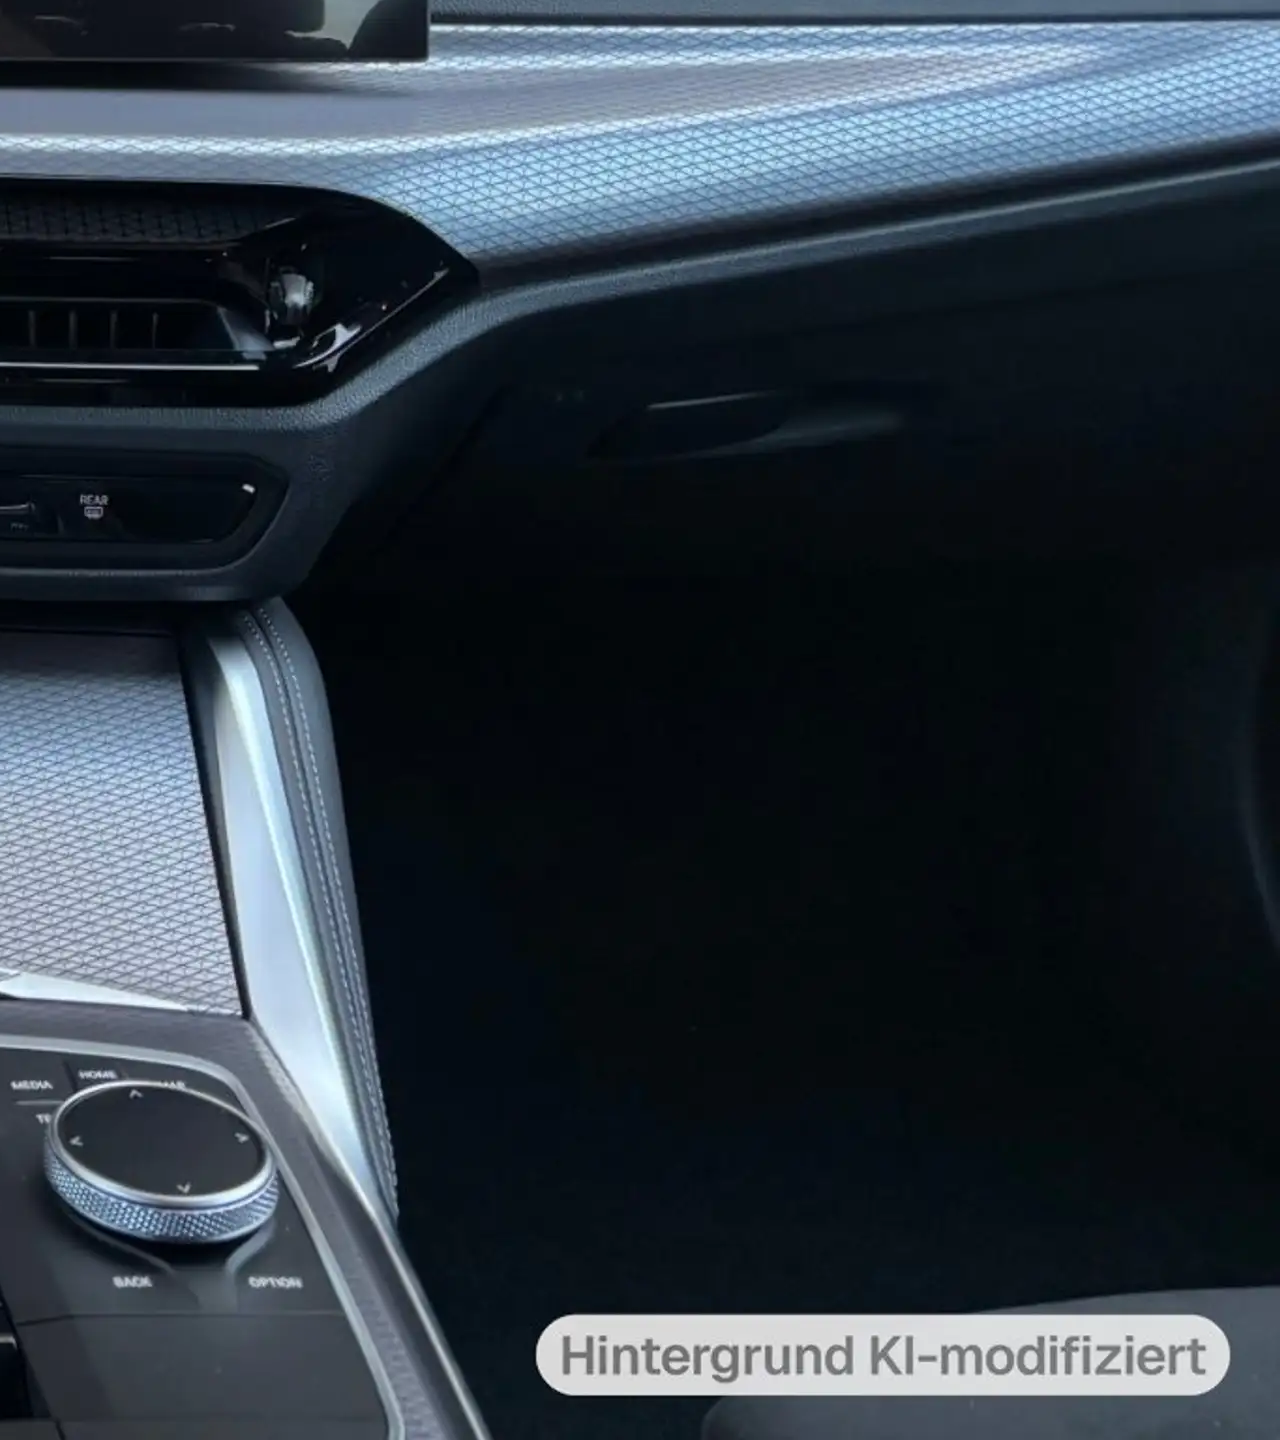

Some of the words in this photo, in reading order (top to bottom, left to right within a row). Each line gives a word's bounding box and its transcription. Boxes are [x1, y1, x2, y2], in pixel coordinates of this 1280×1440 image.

[79, 494, 109, 506] REAR
[78, 1070, 118, 1080] HOME
[10, 1080, 54, 1090] MEDIA
[112, 1276, 154, 1288] BACK
[248, 1276, 303, 1289] OPTION
